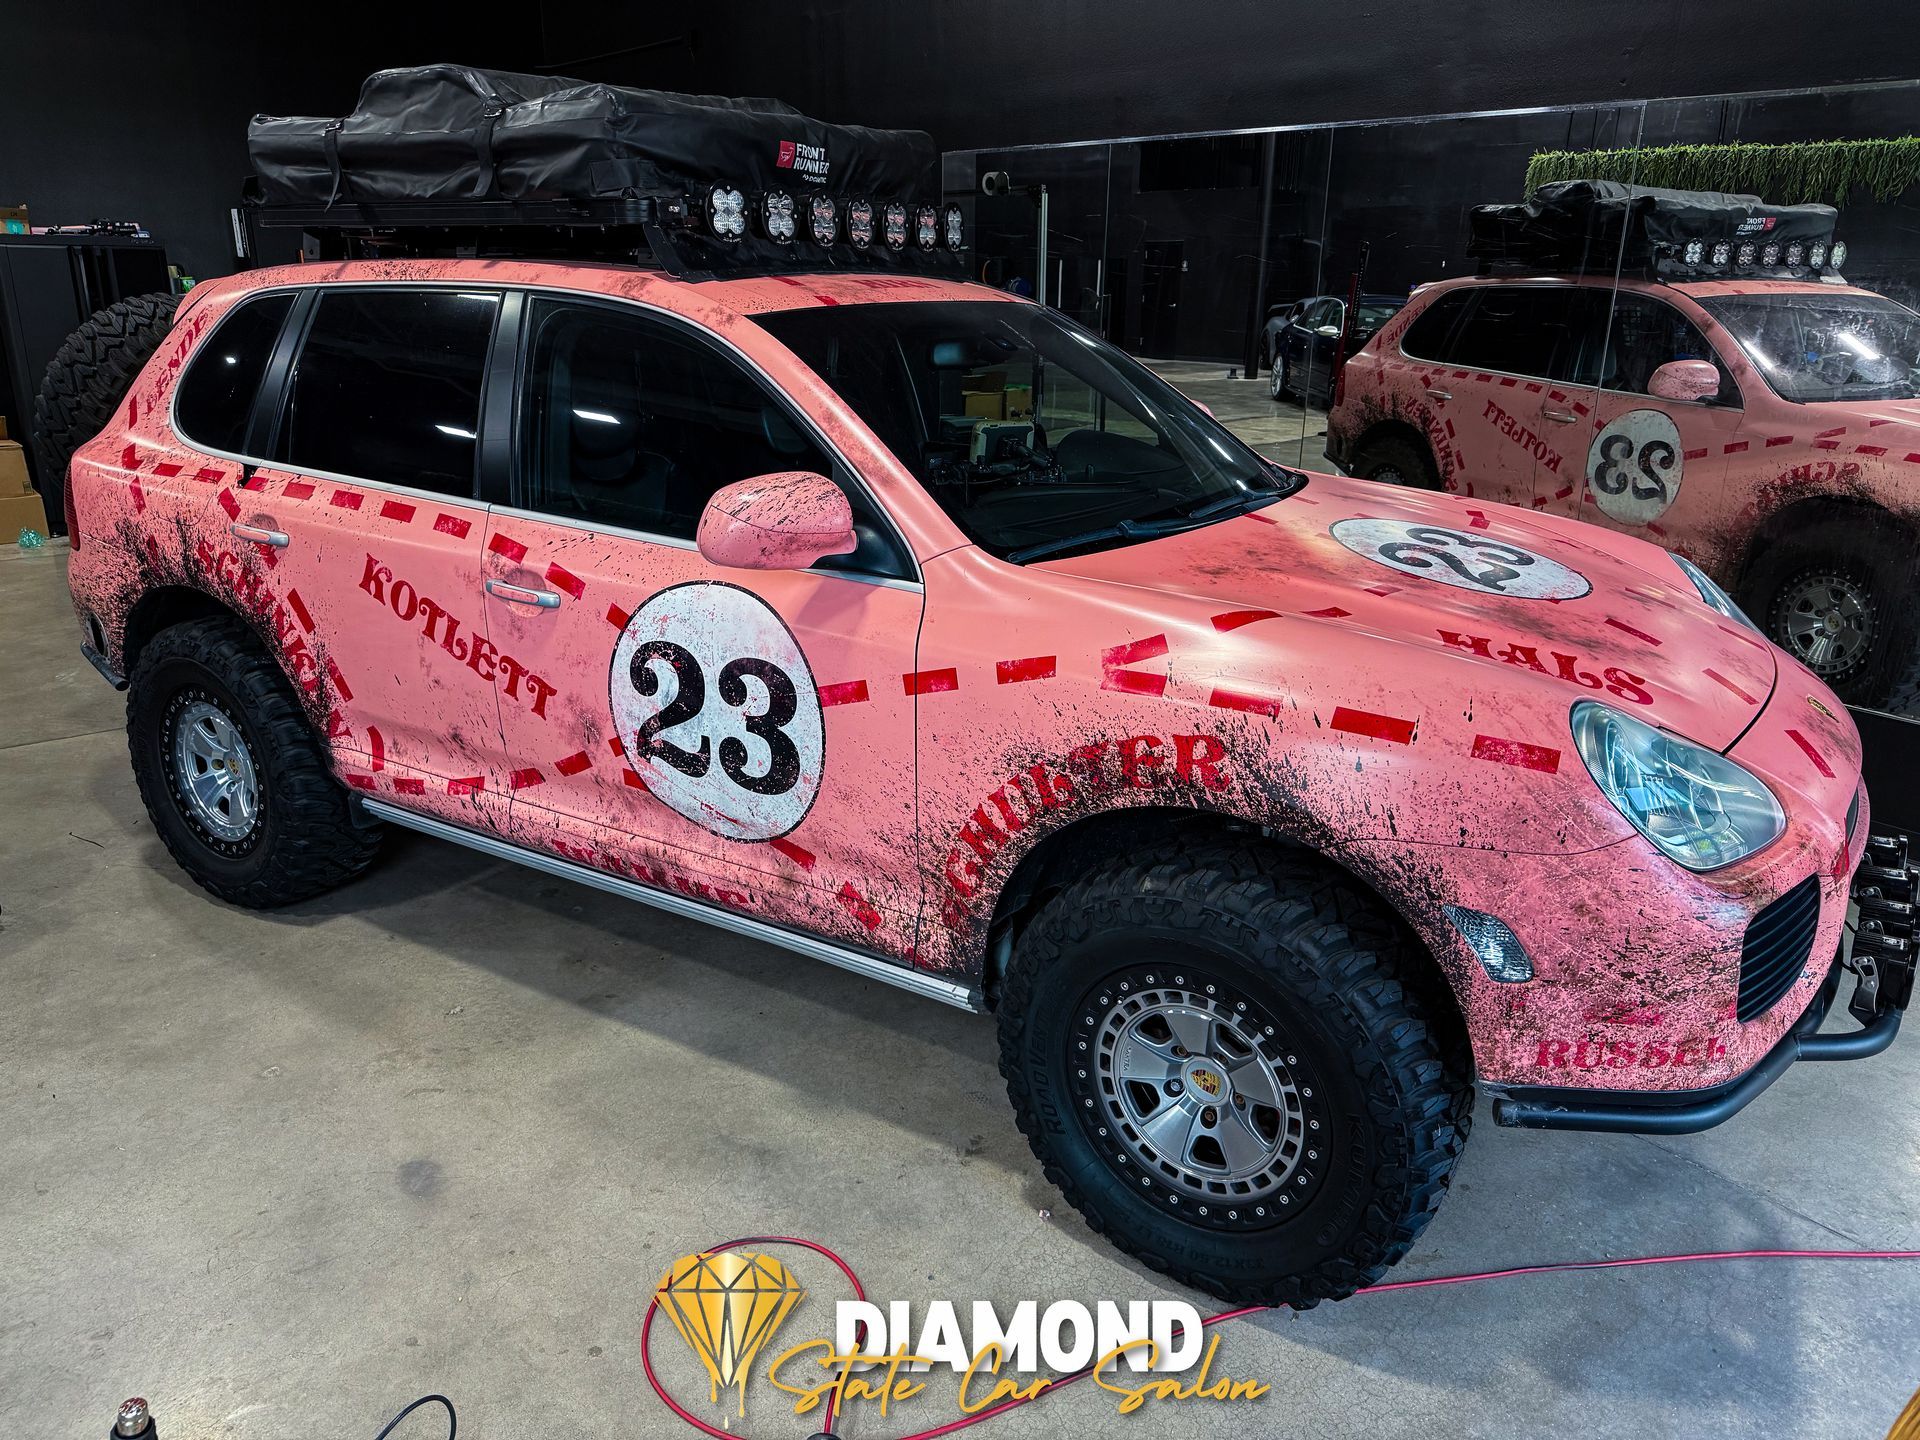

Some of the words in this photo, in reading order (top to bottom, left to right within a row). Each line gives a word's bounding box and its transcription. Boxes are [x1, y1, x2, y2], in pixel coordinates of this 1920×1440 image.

[793, 157, 830, 174] RUNNER
[796, 143, 826, 160] FRONT
[1378, 526, 1537, 593] 23
[358, 552, 558, 721] KOTLETT
[1436, 629, 1654, 705] HALS
[629, 640, 800, 796] 23
